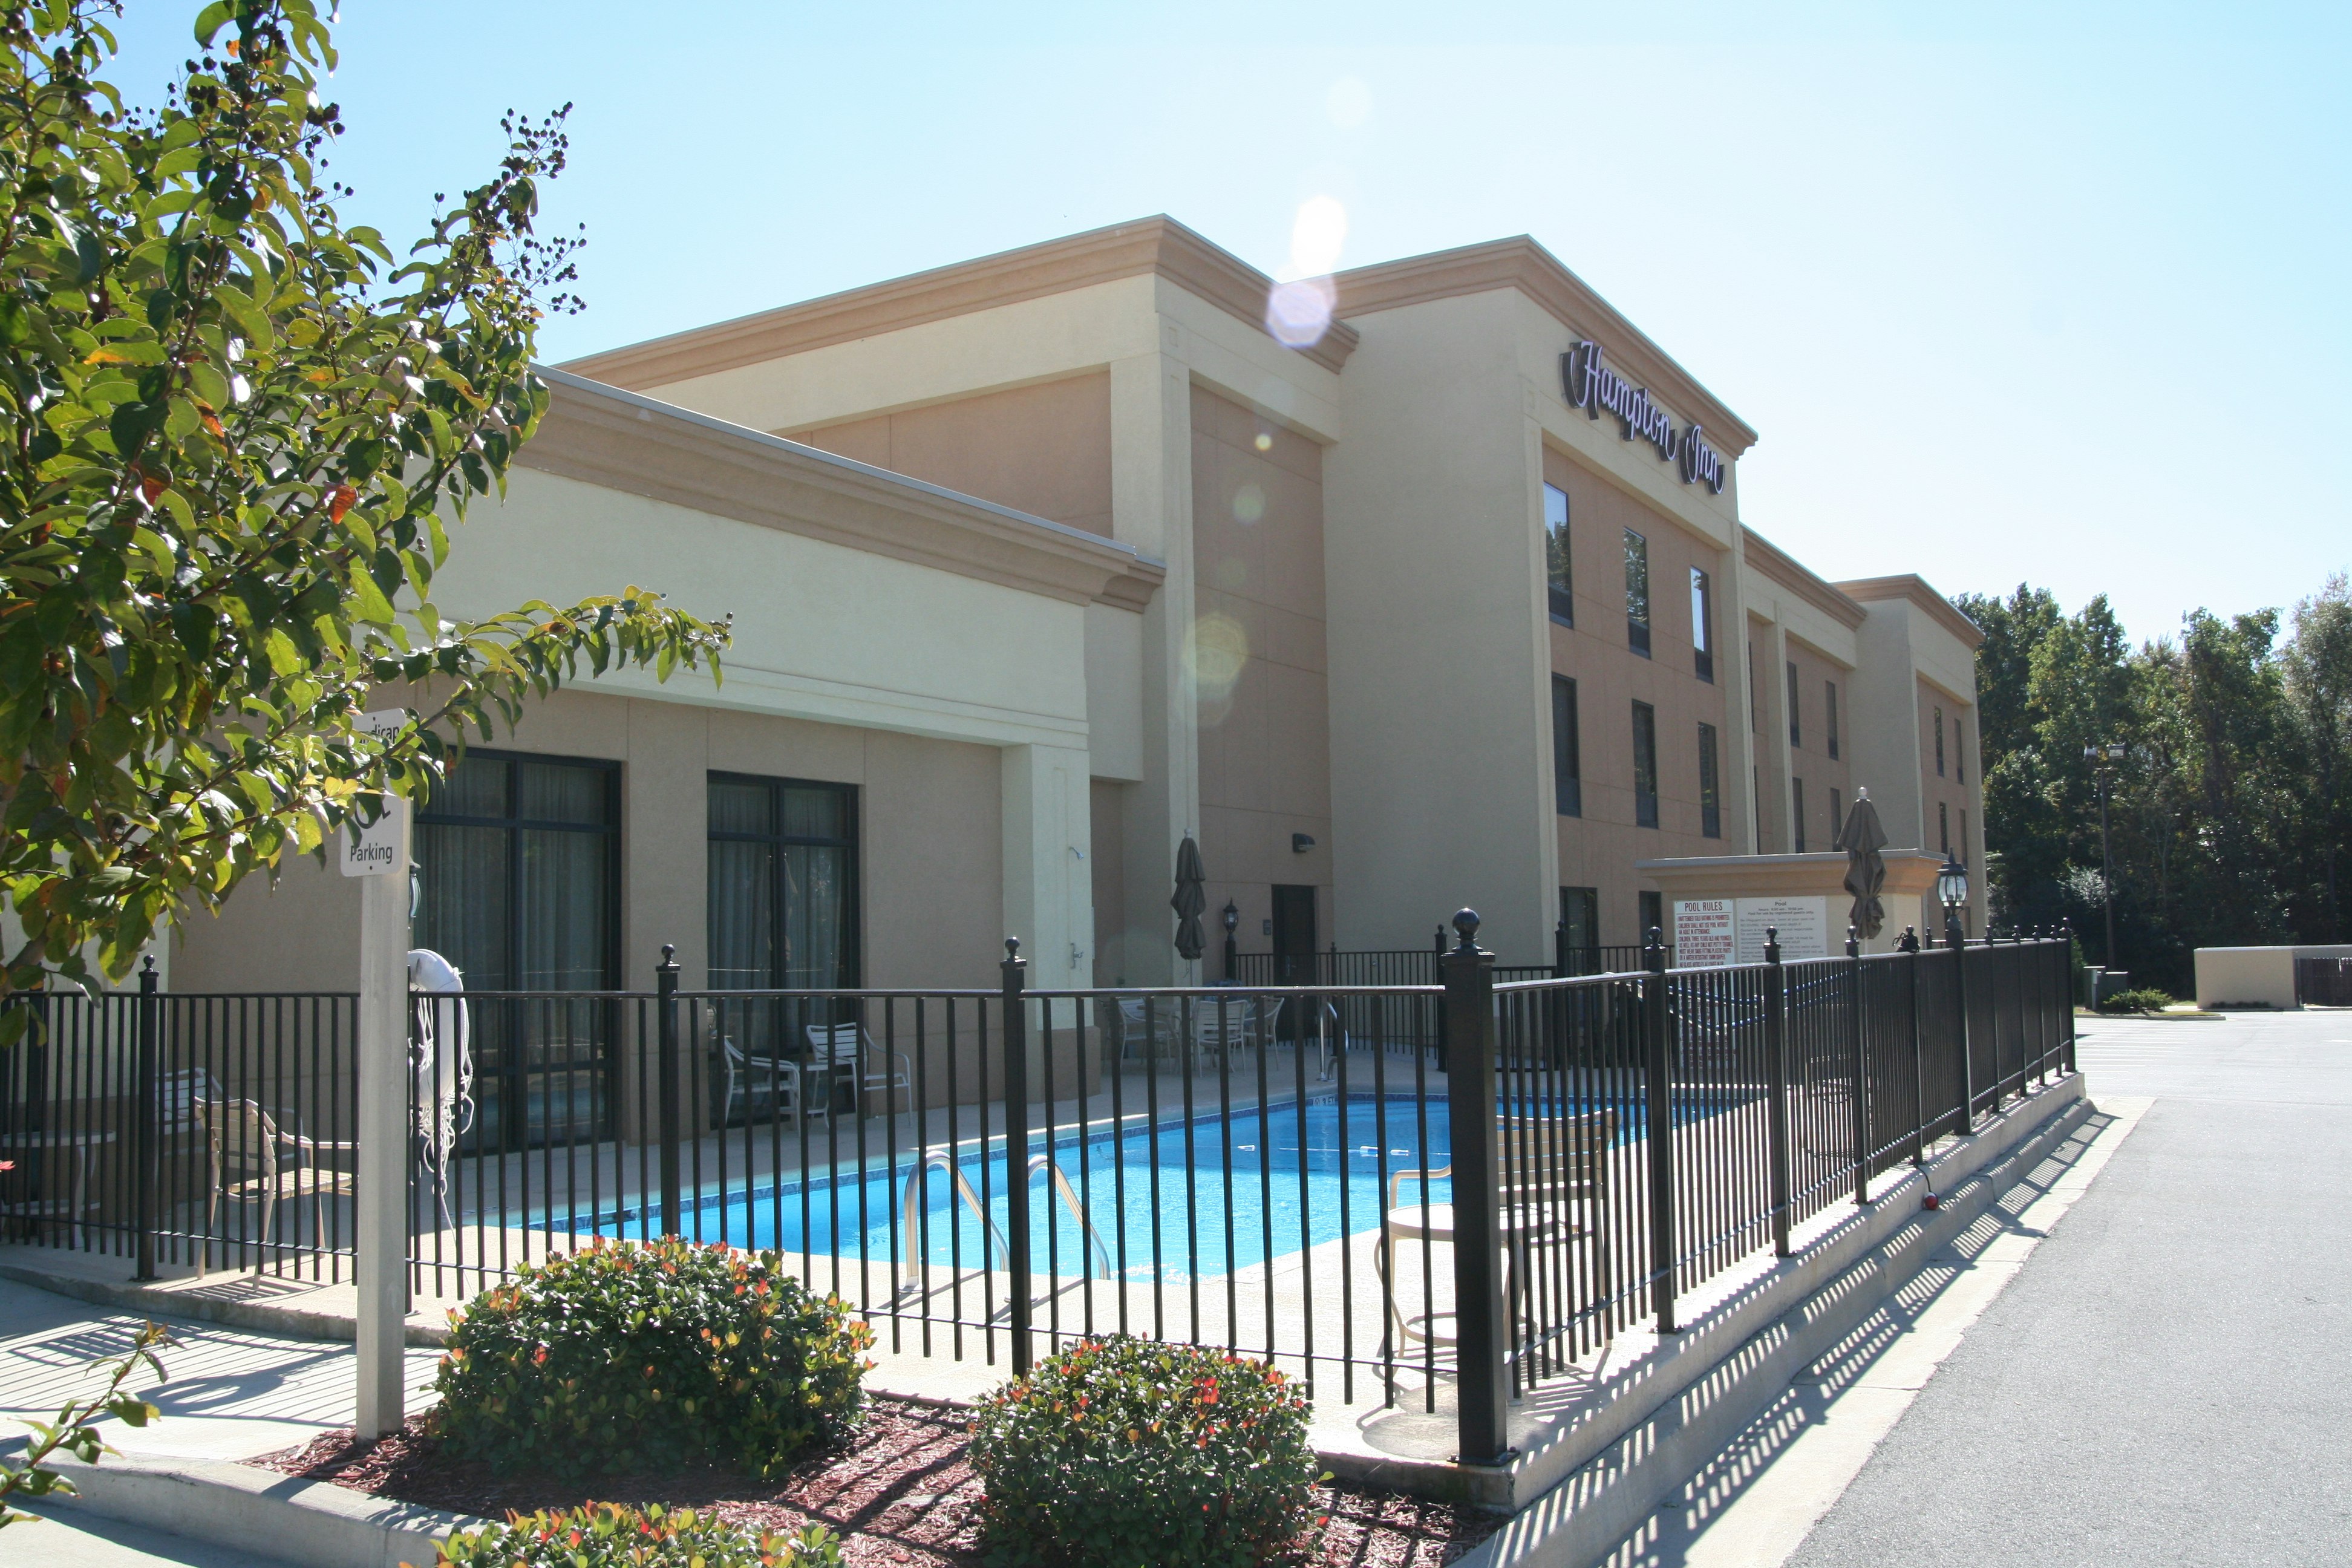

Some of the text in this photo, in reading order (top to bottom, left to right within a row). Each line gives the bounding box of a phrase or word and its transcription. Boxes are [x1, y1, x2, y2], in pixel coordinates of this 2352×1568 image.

[1567, 341, 1725, 494] Hampton Inn
[350, 843, 393, 864] Parking
[1685, 901, 1723, 912] POOL RULES
